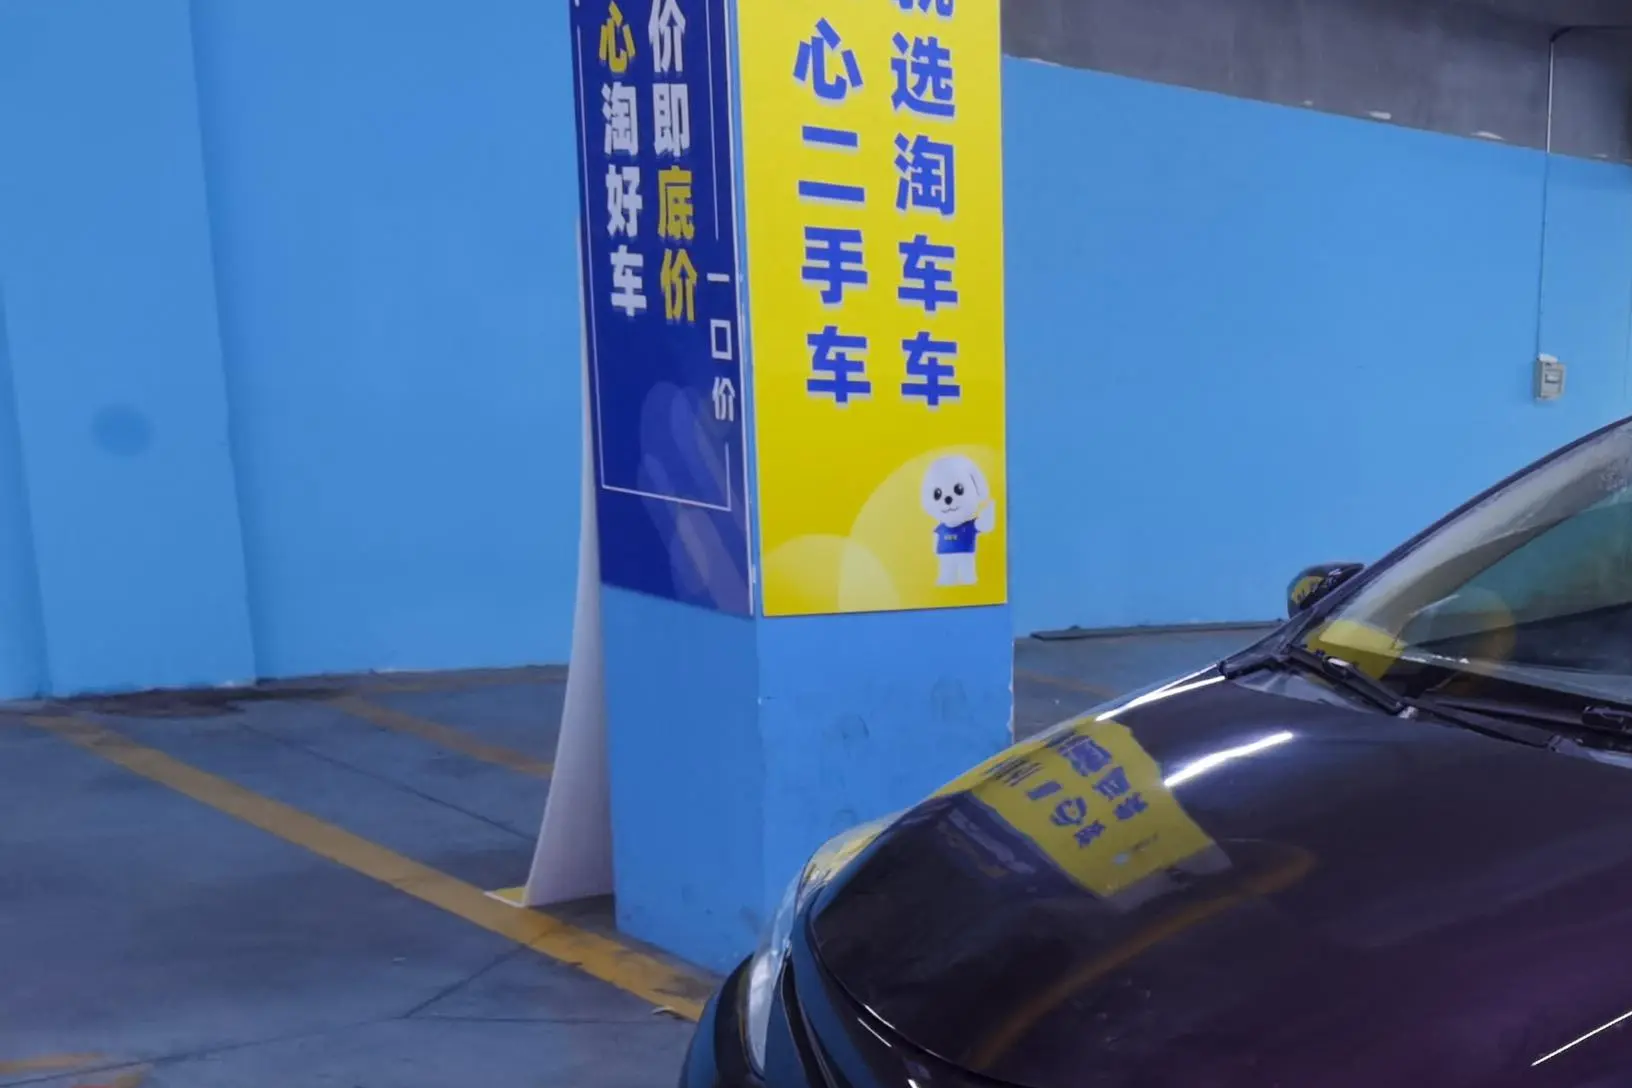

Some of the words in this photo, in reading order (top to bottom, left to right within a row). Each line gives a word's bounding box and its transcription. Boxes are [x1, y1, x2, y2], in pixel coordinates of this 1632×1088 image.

[599, 1, 646, 316] 心淘好车
[648, 0, 697, 322] 价即底价
[793, 17, 872, 403] 心二手车
[889, 0, 961, 406] 选淘车车
[706, 272, 735, 422] 一口价
